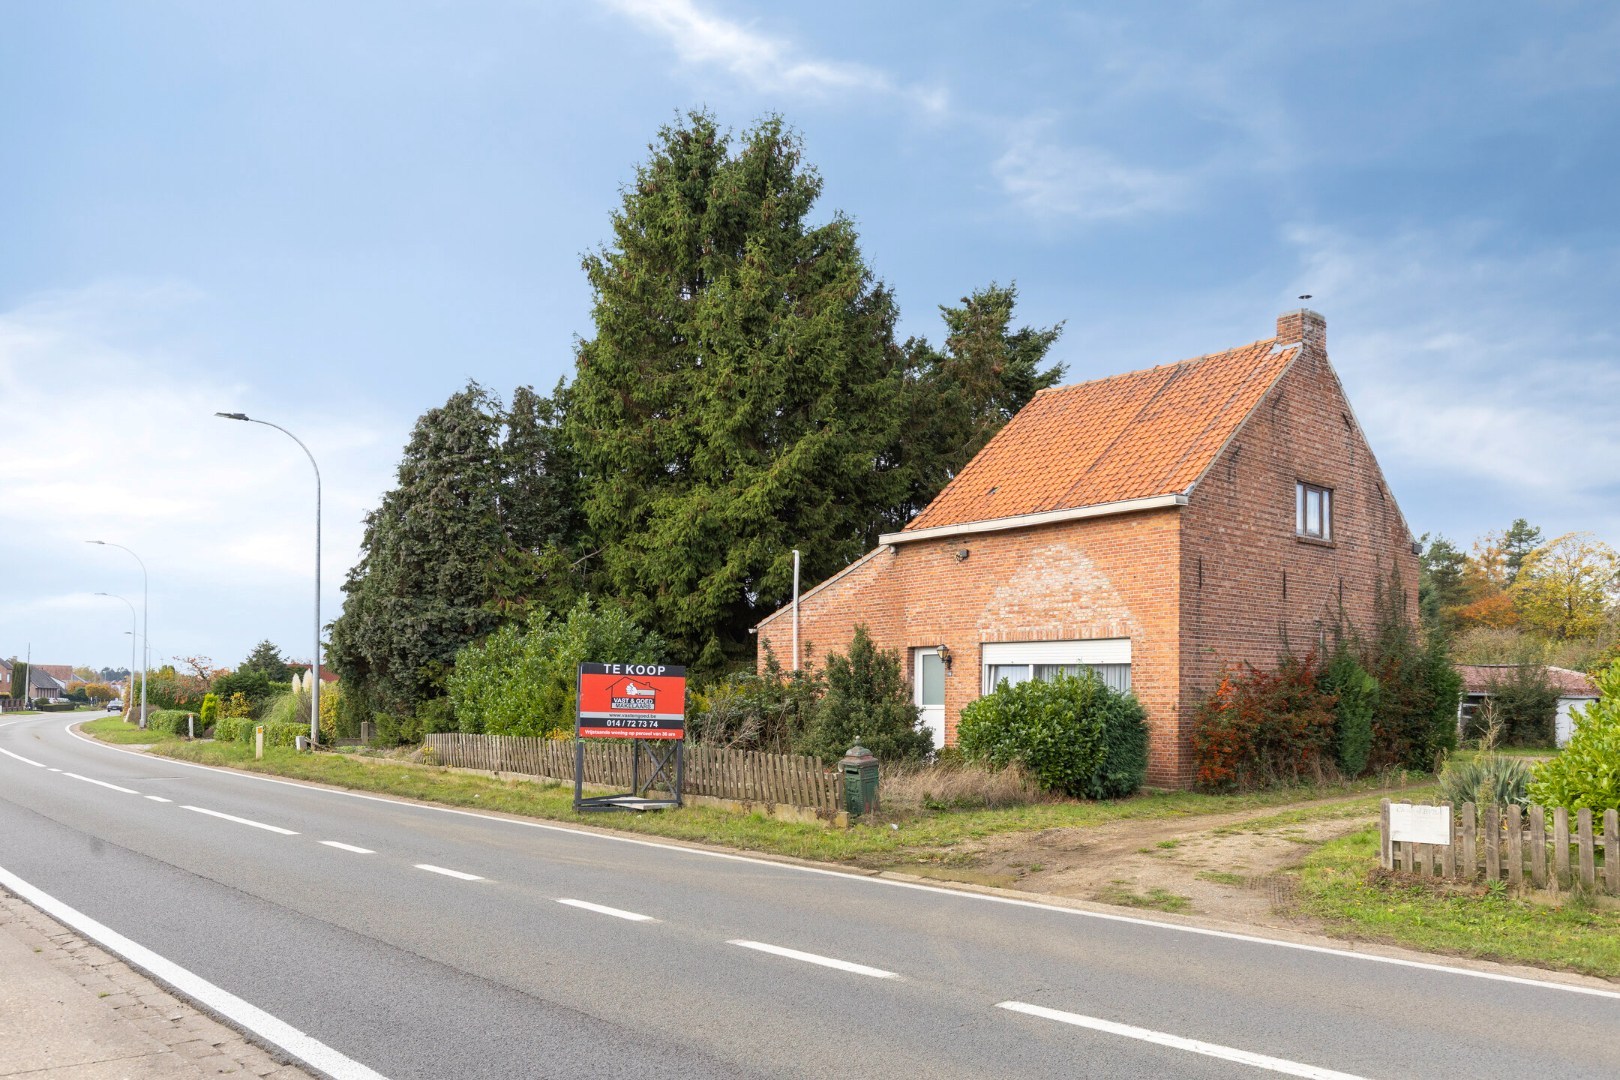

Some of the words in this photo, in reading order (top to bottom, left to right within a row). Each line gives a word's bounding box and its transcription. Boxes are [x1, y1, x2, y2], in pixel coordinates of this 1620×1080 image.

[604, 664, 620, 674] TE
[626, 665, 666, 675] KOOP
[627, 720, 636, 728] 72
[638, 720, 647, 728] 73
